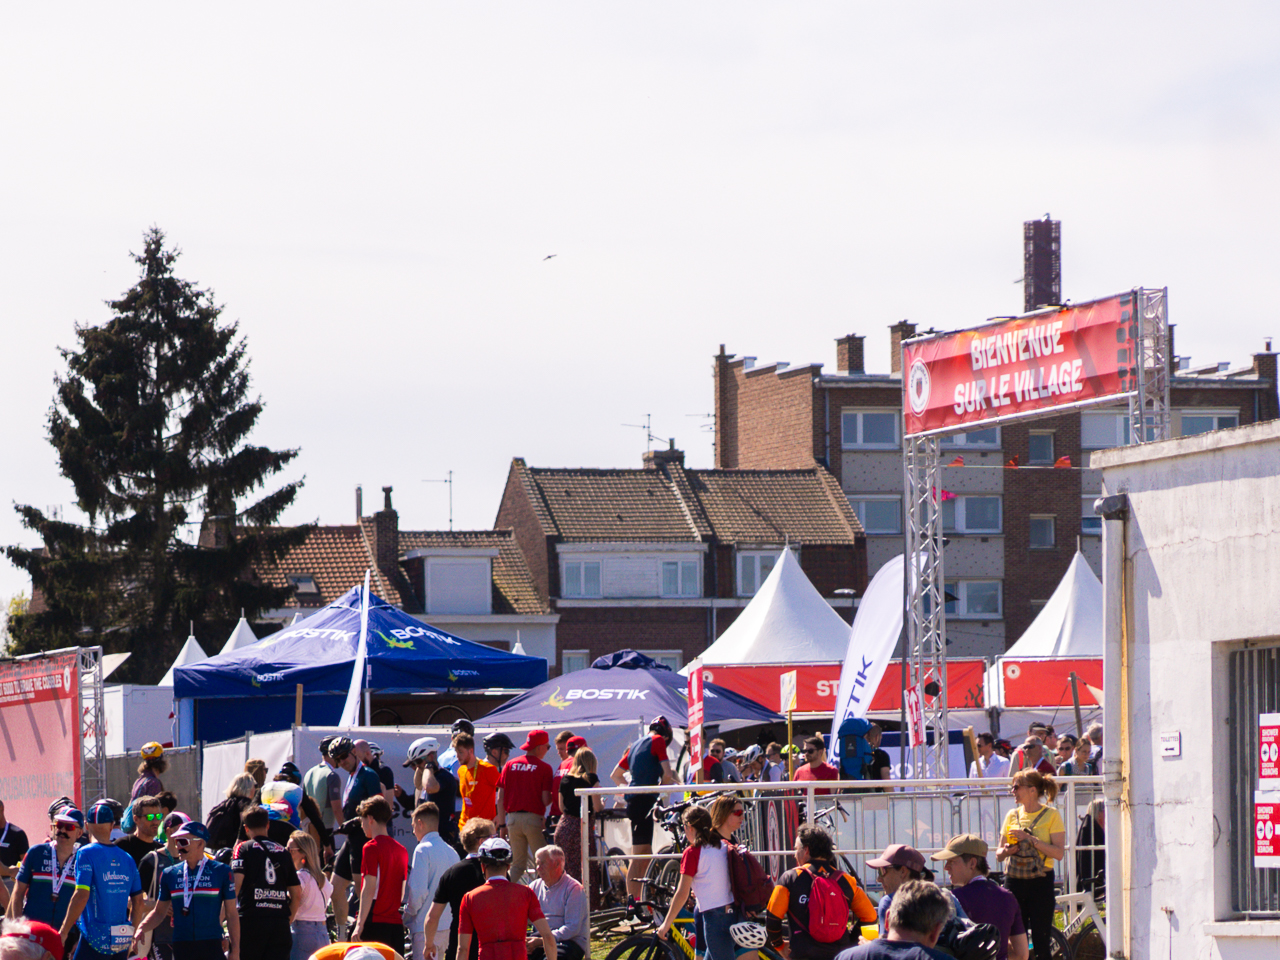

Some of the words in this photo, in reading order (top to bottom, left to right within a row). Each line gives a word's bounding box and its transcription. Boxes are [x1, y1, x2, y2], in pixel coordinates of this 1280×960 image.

[970, 321, 1064, 371] BIENVENUE
[954, 381, 988, 415] SUR
[990, 374, 1011, 408] LE
[1013, 359, 1083, 402] VILLAGE
[34, 677, 43, 691] THE
[565, 688, 650, 701] BOSTIK
[510, 763, 538, 773] STAFF
